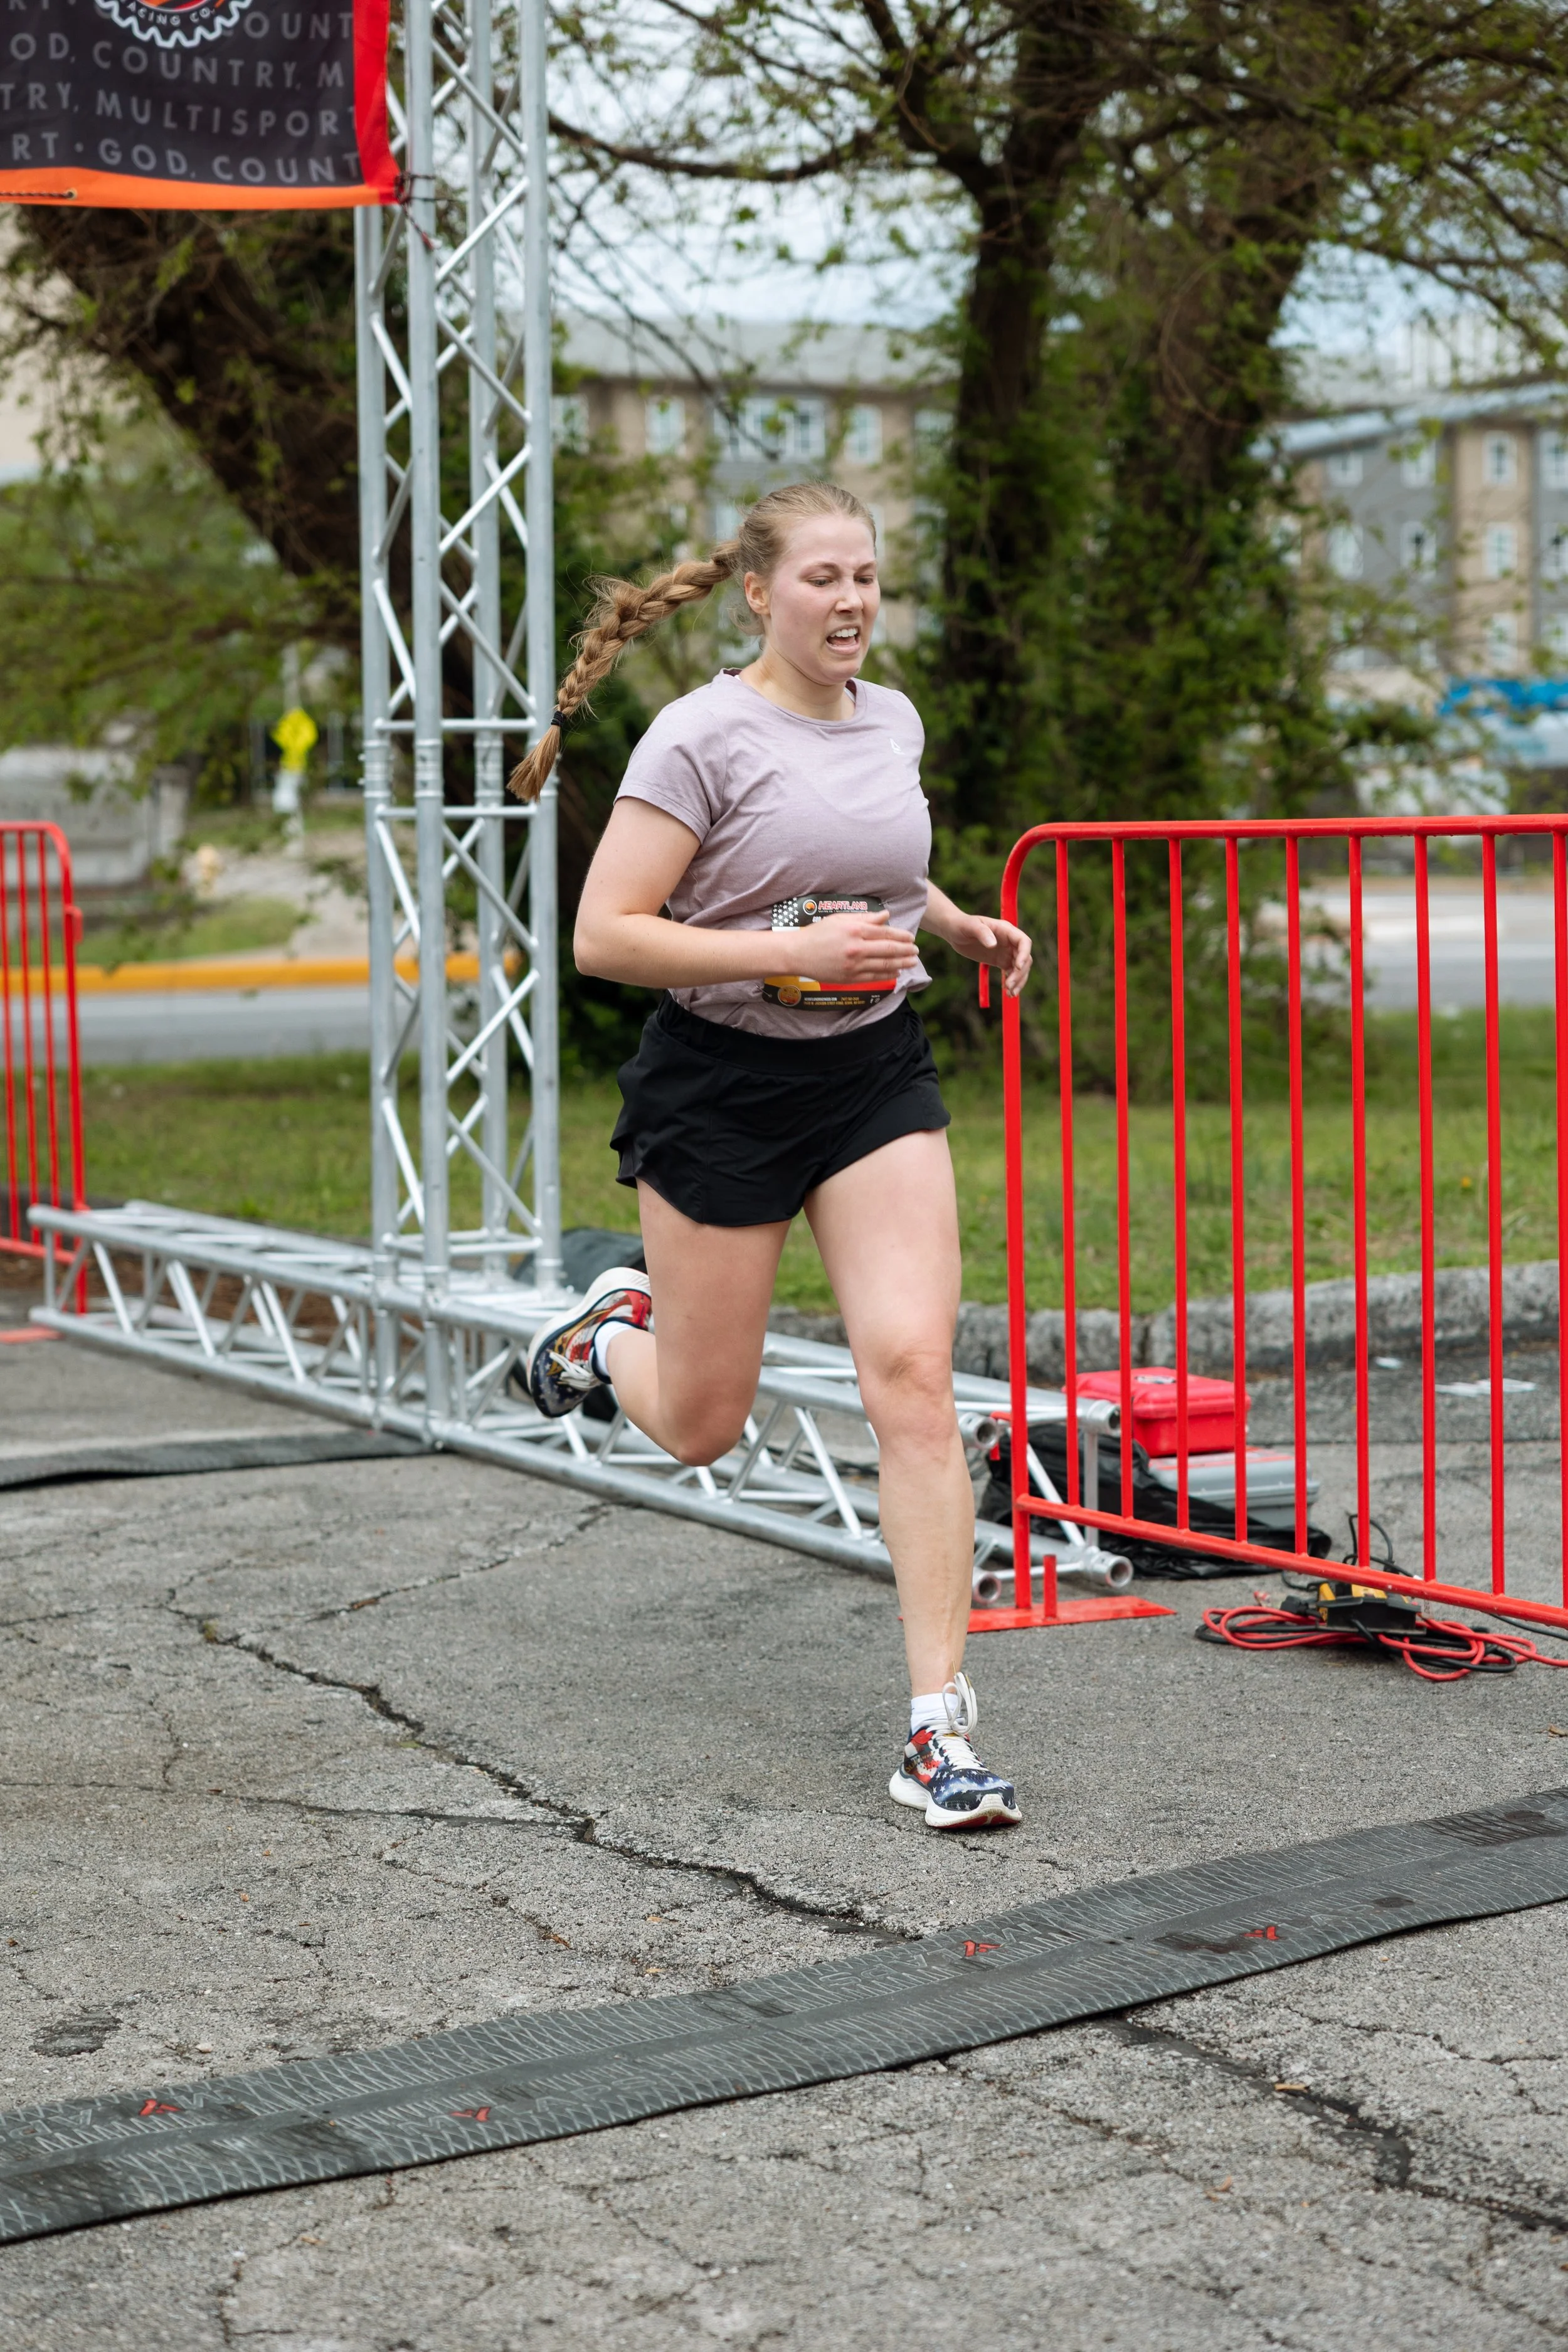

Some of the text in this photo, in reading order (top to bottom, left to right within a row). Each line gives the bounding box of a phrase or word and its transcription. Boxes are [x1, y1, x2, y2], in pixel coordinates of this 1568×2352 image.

[121, 0, 181, 26] ACING
[220, 11, 354, 40] OUNT
[92, 41, 301, 90] COUNTRY,
[317, 61, 345, 88] M
[96, 88, 356, 137] MULTISPOR
[98, 138, 196, 179] GOD,
[818, 901, 868, 911] HEARTLAND
